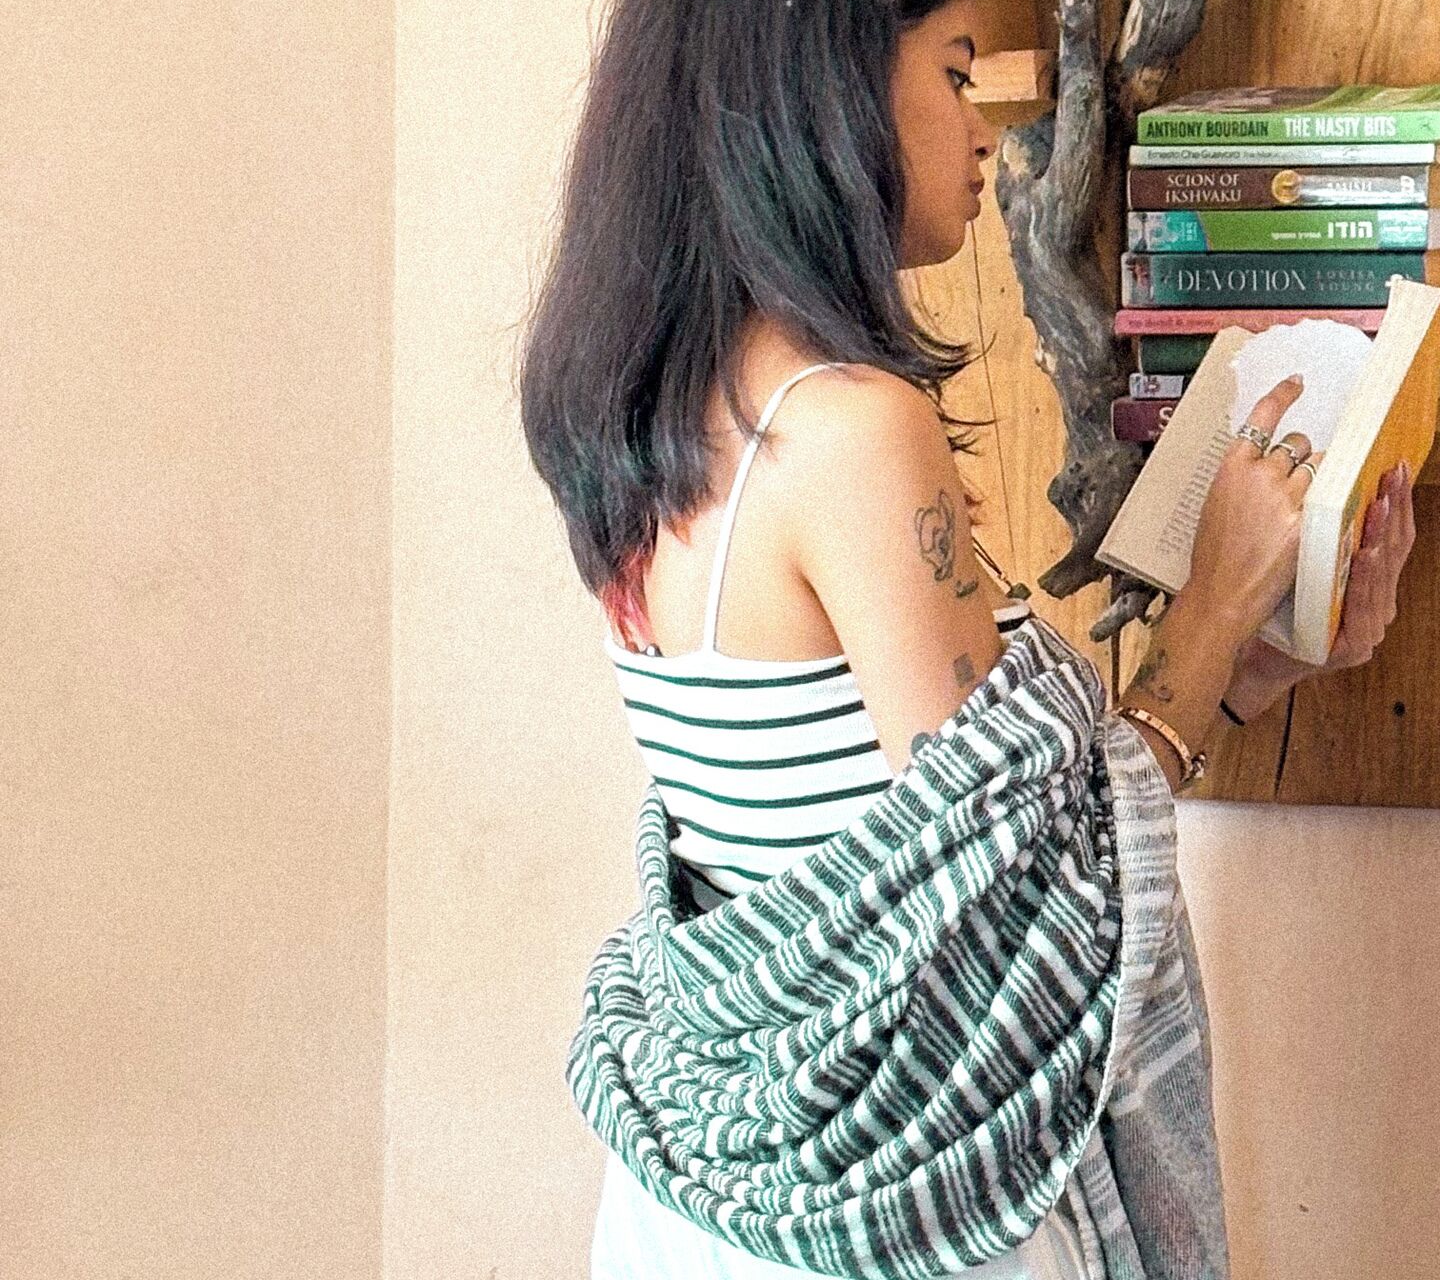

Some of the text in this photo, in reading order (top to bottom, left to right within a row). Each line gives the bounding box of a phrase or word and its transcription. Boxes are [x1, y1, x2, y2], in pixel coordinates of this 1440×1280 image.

[1146, 121, 1269, 138] ANTHONY BOURDAIN
[1284, 116, 1396, 137] THE NASTY BITS
[1167, 174, 1239, 187] SCION OF
[1165, 189, 1241, 203] IKSHVAKU
[1328, 221, 1373, 238] הודו
[1178, 269, 1306, 291] DEVOTION
